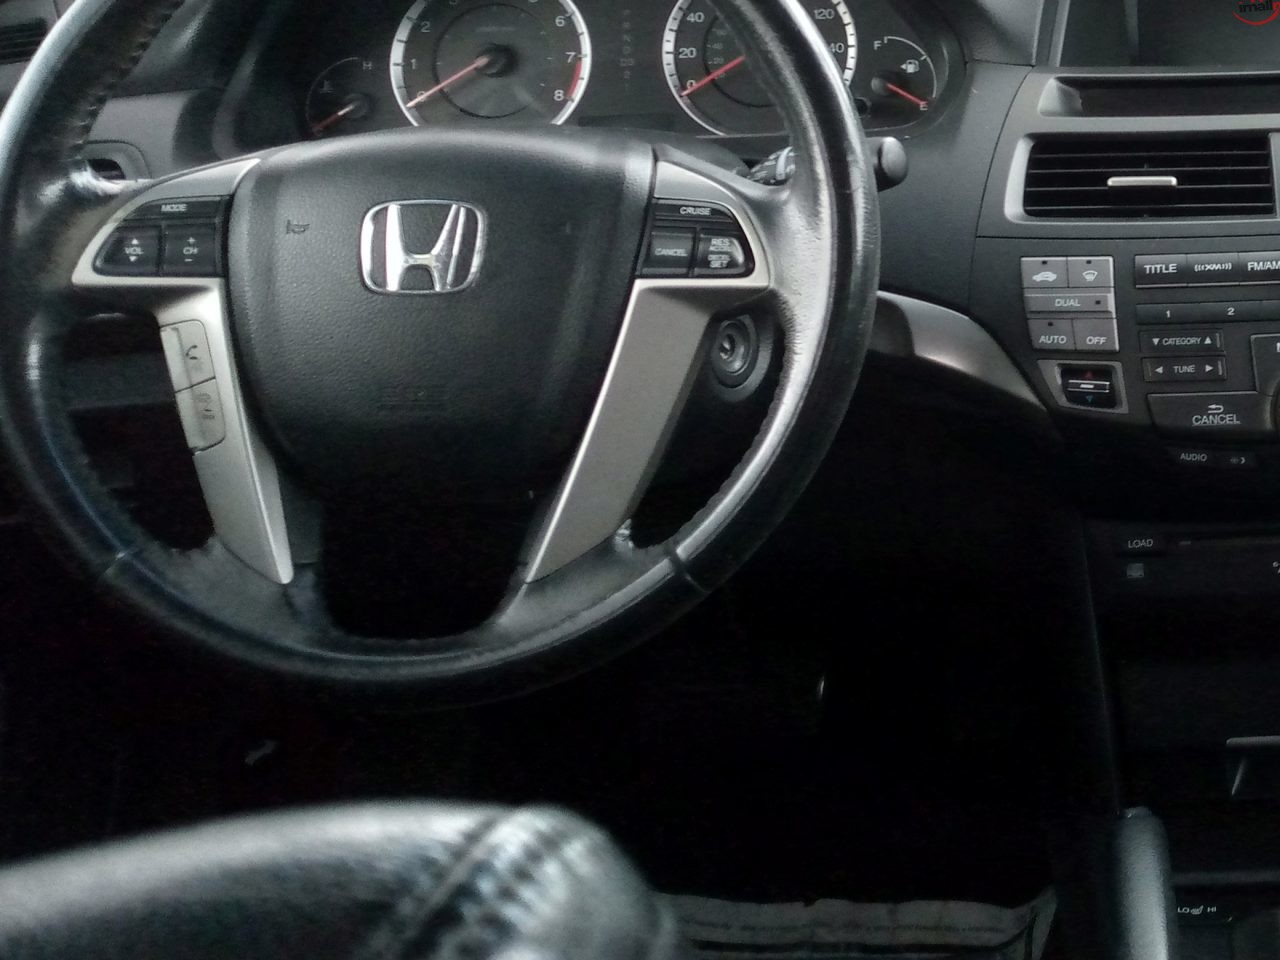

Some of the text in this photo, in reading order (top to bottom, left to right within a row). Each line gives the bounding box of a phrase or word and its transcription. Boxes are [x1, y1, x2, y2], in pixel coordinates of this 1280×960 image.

[686, 12, 704, 23] 40
[814, 9, 835, 20] 120
[555, 16, 565, 27] 6
[421, 21, 431, 33] 2
[828, 43, 845, 53] 40
[874, 41, 882, 50] F
[565, 52, 576, 62] 7
[679, 47, 697, 58] 20
[411, 59, 416, 69] 1
[553, 89, 564, 100] 8
[920, 102, 928, 111] E
[161, 204, 188, 212] MODE
[680, 206, 712, 216] CRUISE
[183, 246, 199, 255] CH
[655, 247, 688, 257] CANCEL
[1143, 263, 1177, 274] TITLE
[1055, 298, 1081, 307] DUAL
[1165, 310, 1171, 318] 1
[1227, 308, 1235, 316] 2
[1039, 335, 1067, 345] AUTO
[1086, 336, 1107, 345] OFF
[1162, 337, 1202, 346] CATEGORY
[1173, 365, 1196, 374] TUNE
[1192, 413, 1241, 425] CANCEL
[1180, 452, 1207, 462] AUDIO
[1127, 539, 1154, 549] LOAD
